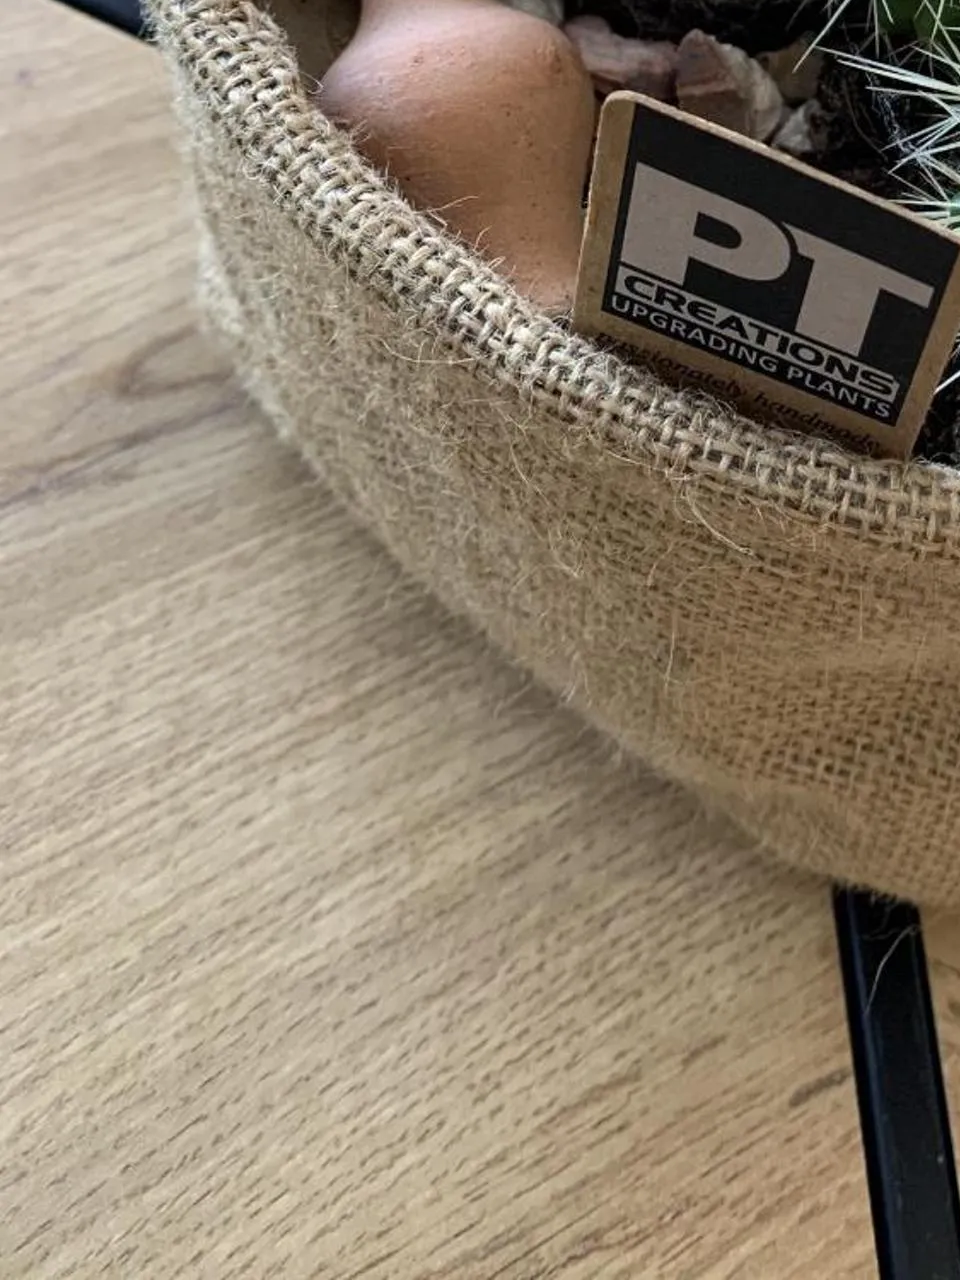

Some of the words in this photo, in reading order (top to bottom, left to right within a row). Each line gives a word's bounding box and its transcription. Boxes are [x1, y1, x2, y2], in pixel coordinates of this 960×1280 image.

[620, 161, 936, 358] PT
[611, 295, 779, 372] UPGRADING
[786, 366, 892, 419] PLANTS
[622, 275, 898, 397] CREATIONS
